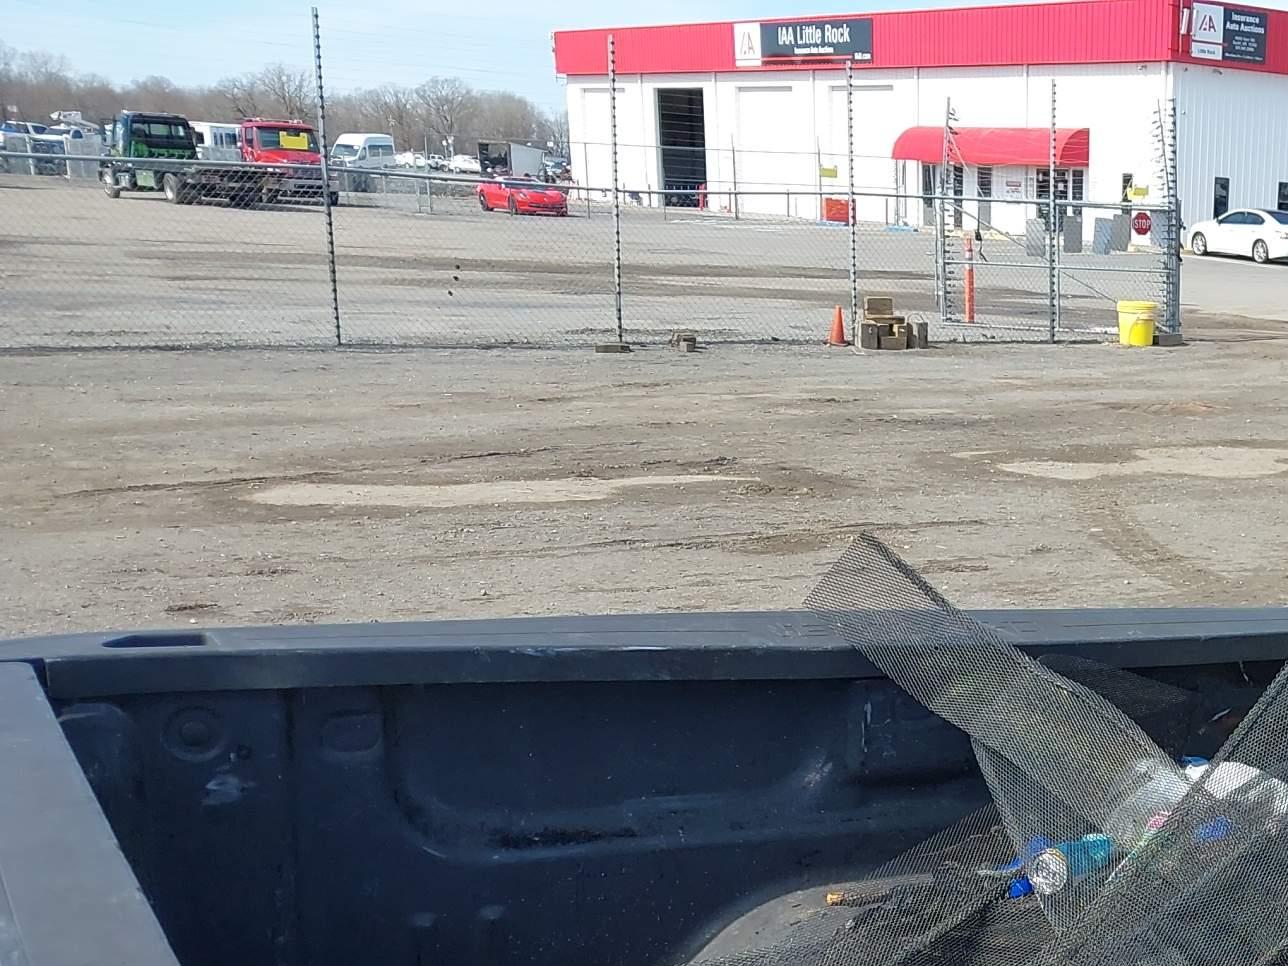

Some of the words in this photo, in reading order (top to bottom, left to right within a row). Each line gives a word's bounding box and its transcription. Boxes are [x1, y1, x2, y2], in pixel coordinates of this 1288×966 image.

[1231, 11, 1260, 24] Insurance
[1225, 20, 1239, 31] Auto
[1240, 21, 1265, 34] Auctions
[778, 26, 795, 45] IAA
[797, 25, 822, 45] Little
[824, 23, 851, 44] Rock
[1134, 219, 1151, 229] STOP
